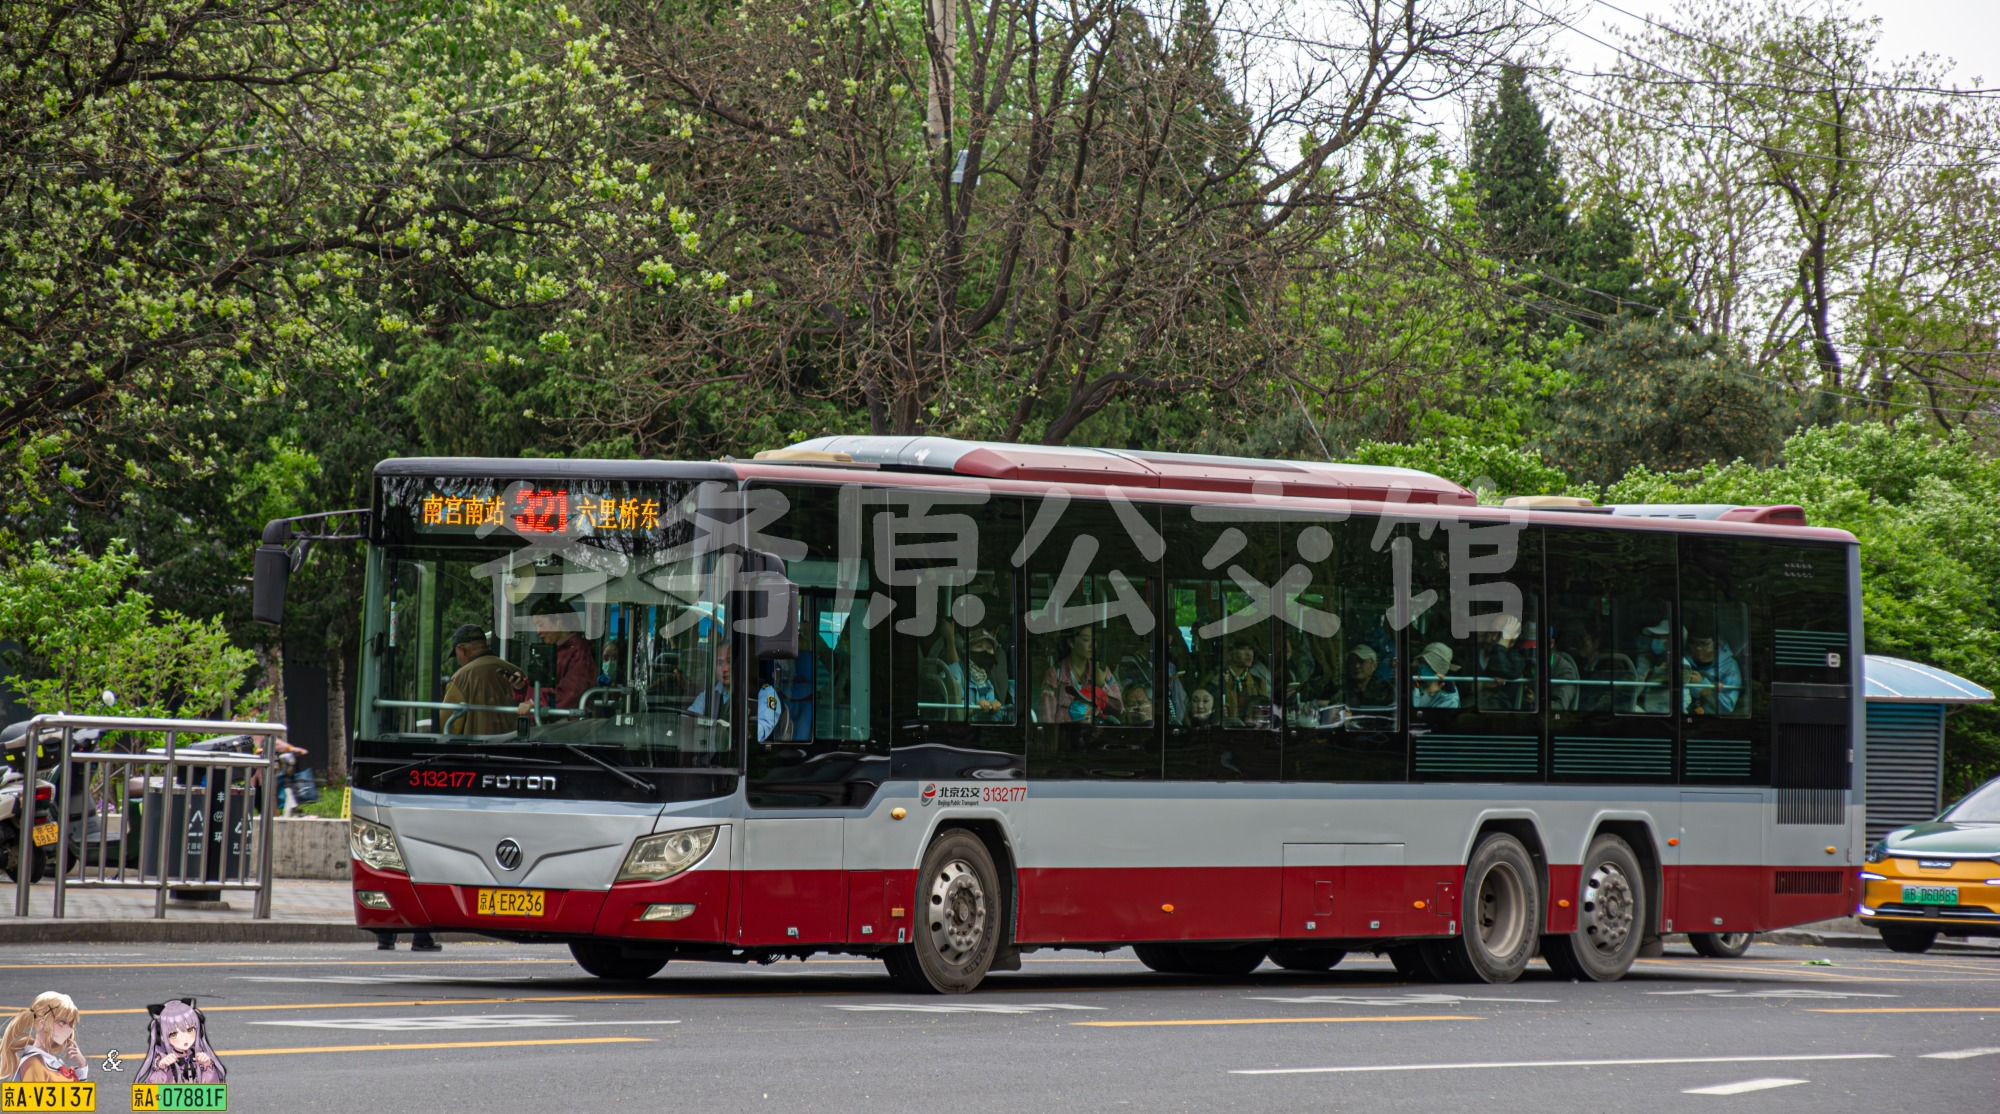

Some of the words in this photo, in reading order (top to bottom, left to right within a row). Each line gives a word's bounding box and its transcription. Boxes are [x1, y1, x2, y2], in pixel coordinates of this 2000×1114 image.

[423, 493, 505, 526] 南宫南站
[515, 490, 568, 532] 321
[576, 497, 660, 530] 六里桥东
[409, 769, 477, 788] 3132177
[482, 775, 556, 790] FOTON
[938, 786, 981, 798] 北京公交
[982, 787, 1027, 802] 3132177
[961, 799, 979, 807] Transport
